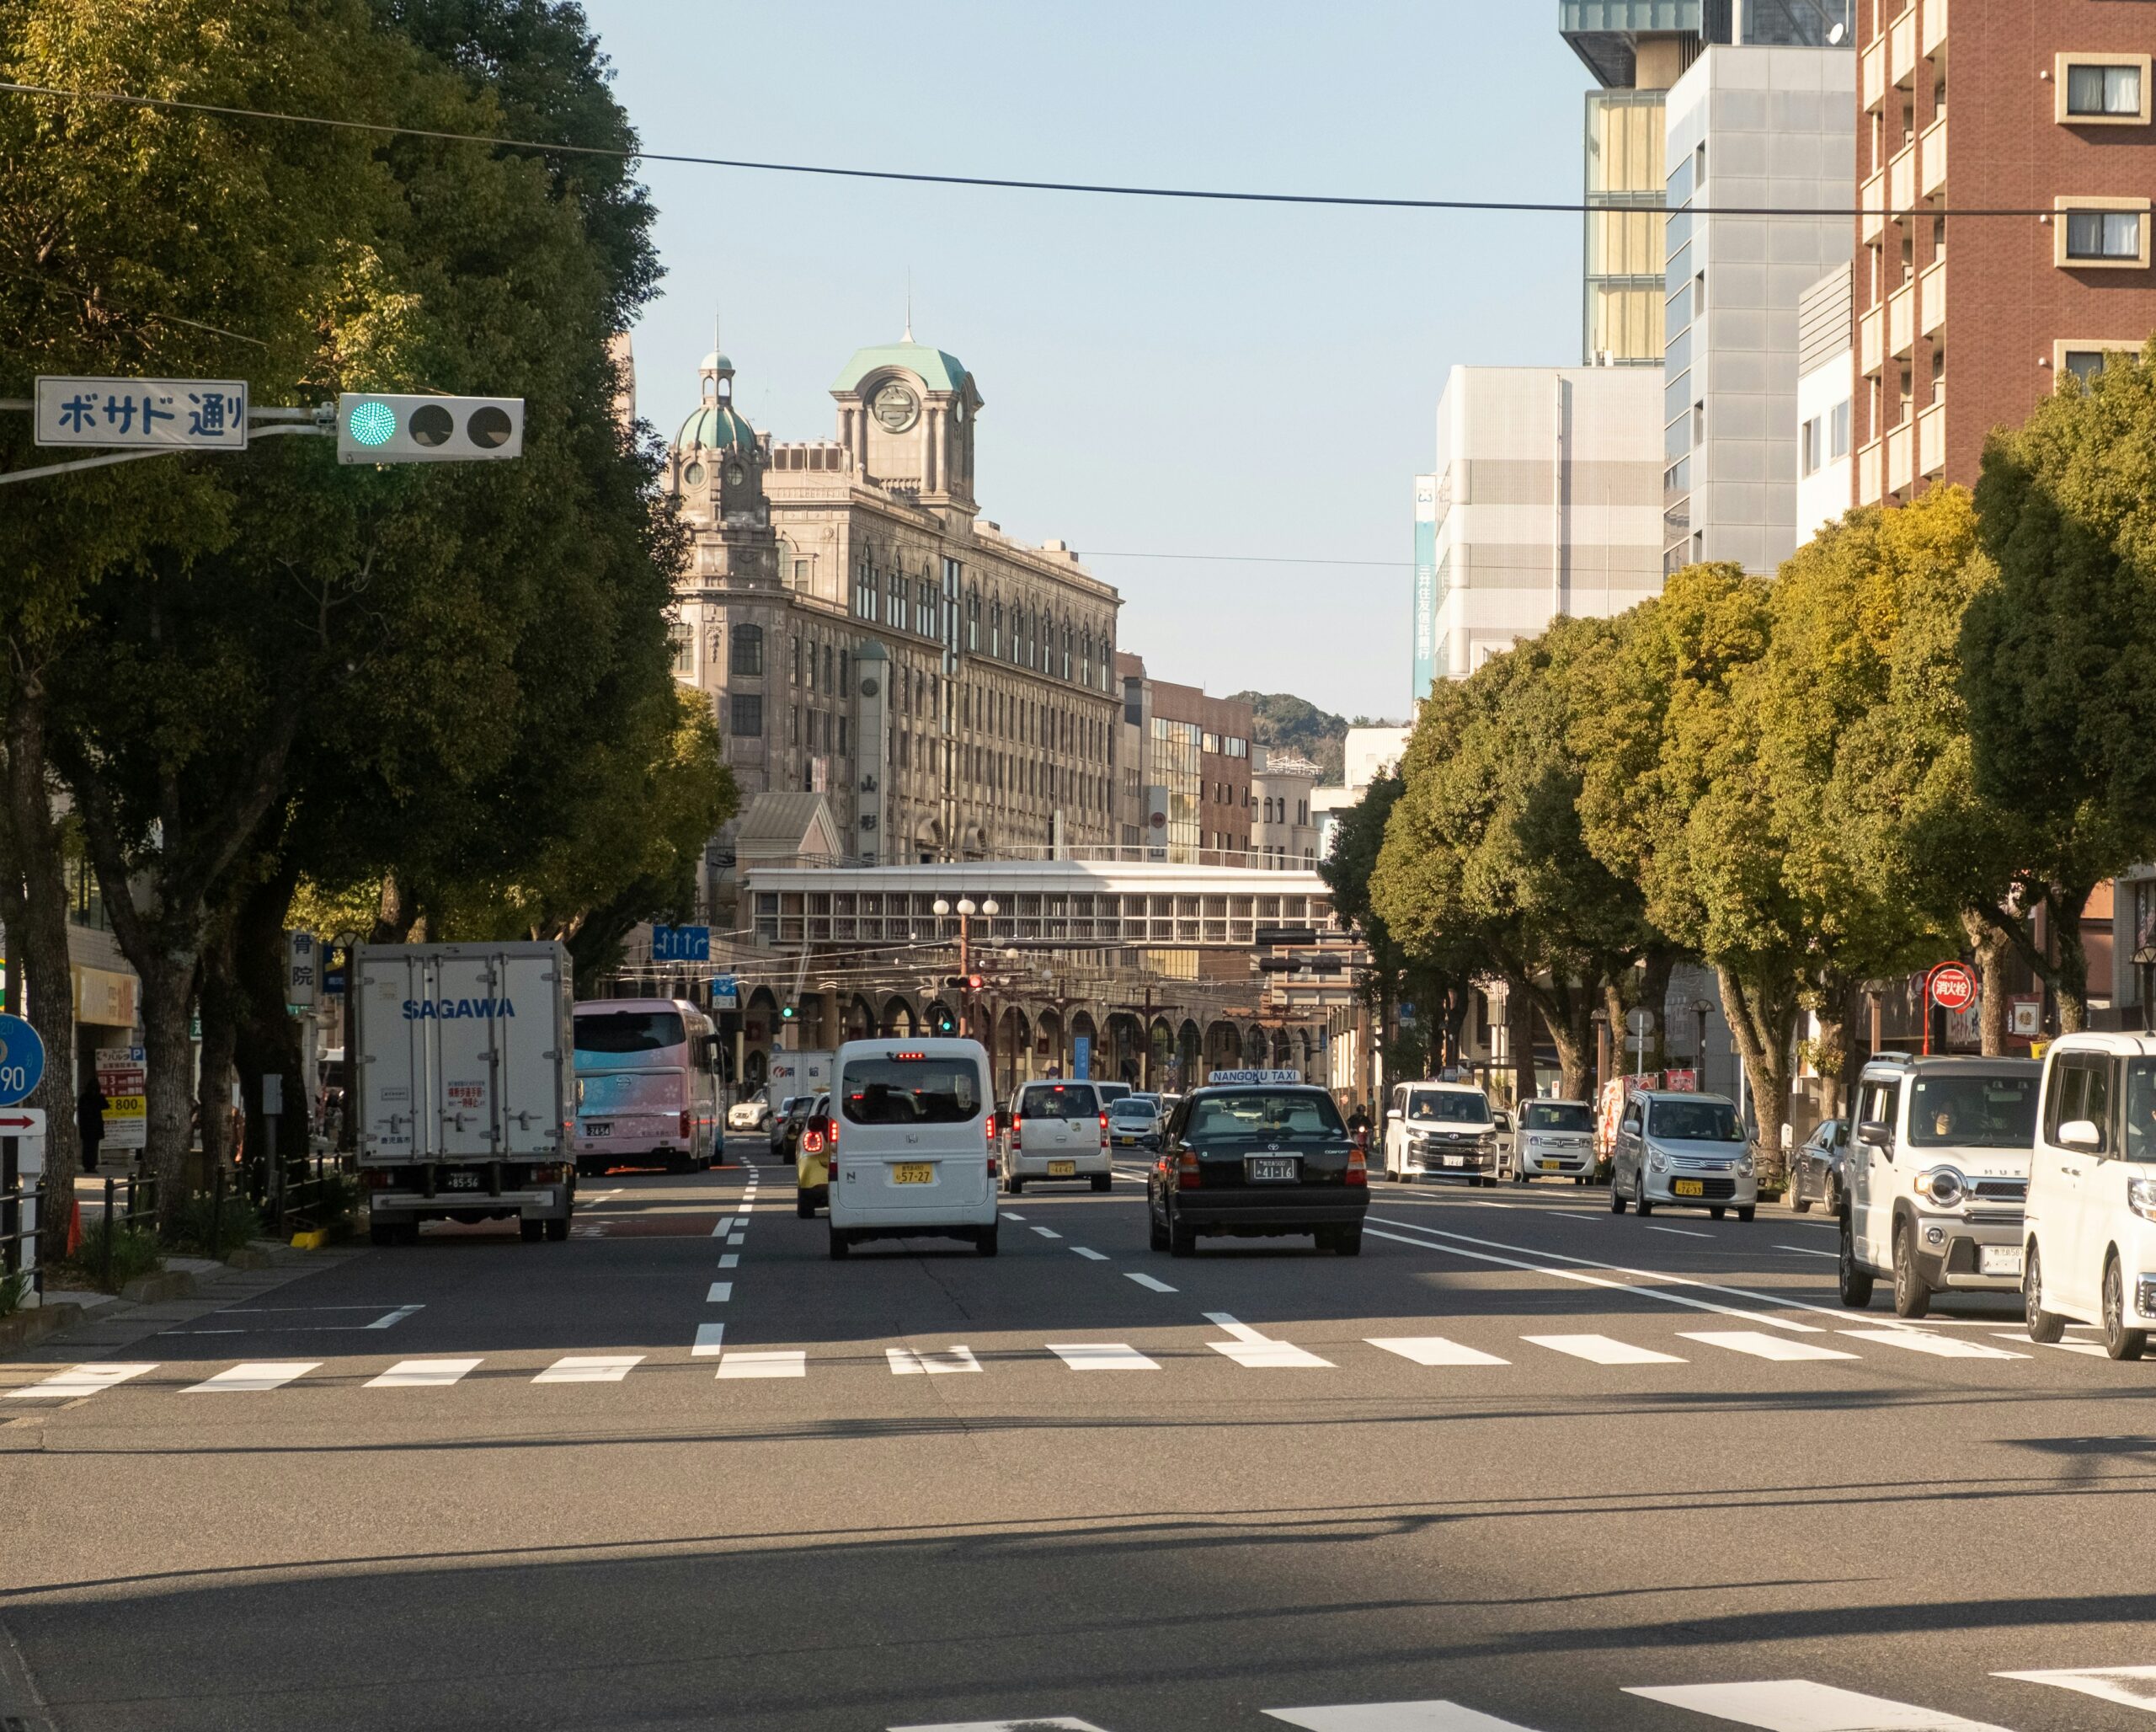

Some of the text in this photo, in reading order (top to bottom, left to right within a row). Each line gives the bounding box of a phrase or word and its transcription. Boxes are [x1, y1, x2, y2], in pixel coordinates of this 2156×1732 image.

[1417, 565, 1431, 660] 三井住友信託銀行
[1936, 981, 1967, 997] 消火栓
[403, 997, 515, 1019] SAGAWA
[1, 1066, 24, 1091] 90
[1214, 1071, 1296, 1081] NANGOKU TAXI
[115, 1099, 138, 1110] 800
[901, 1172, 930, 1182] 57-27
[1262, 1167, 1291, 1178] 41-16
[453, 1179, 478, 1187] 85-56
